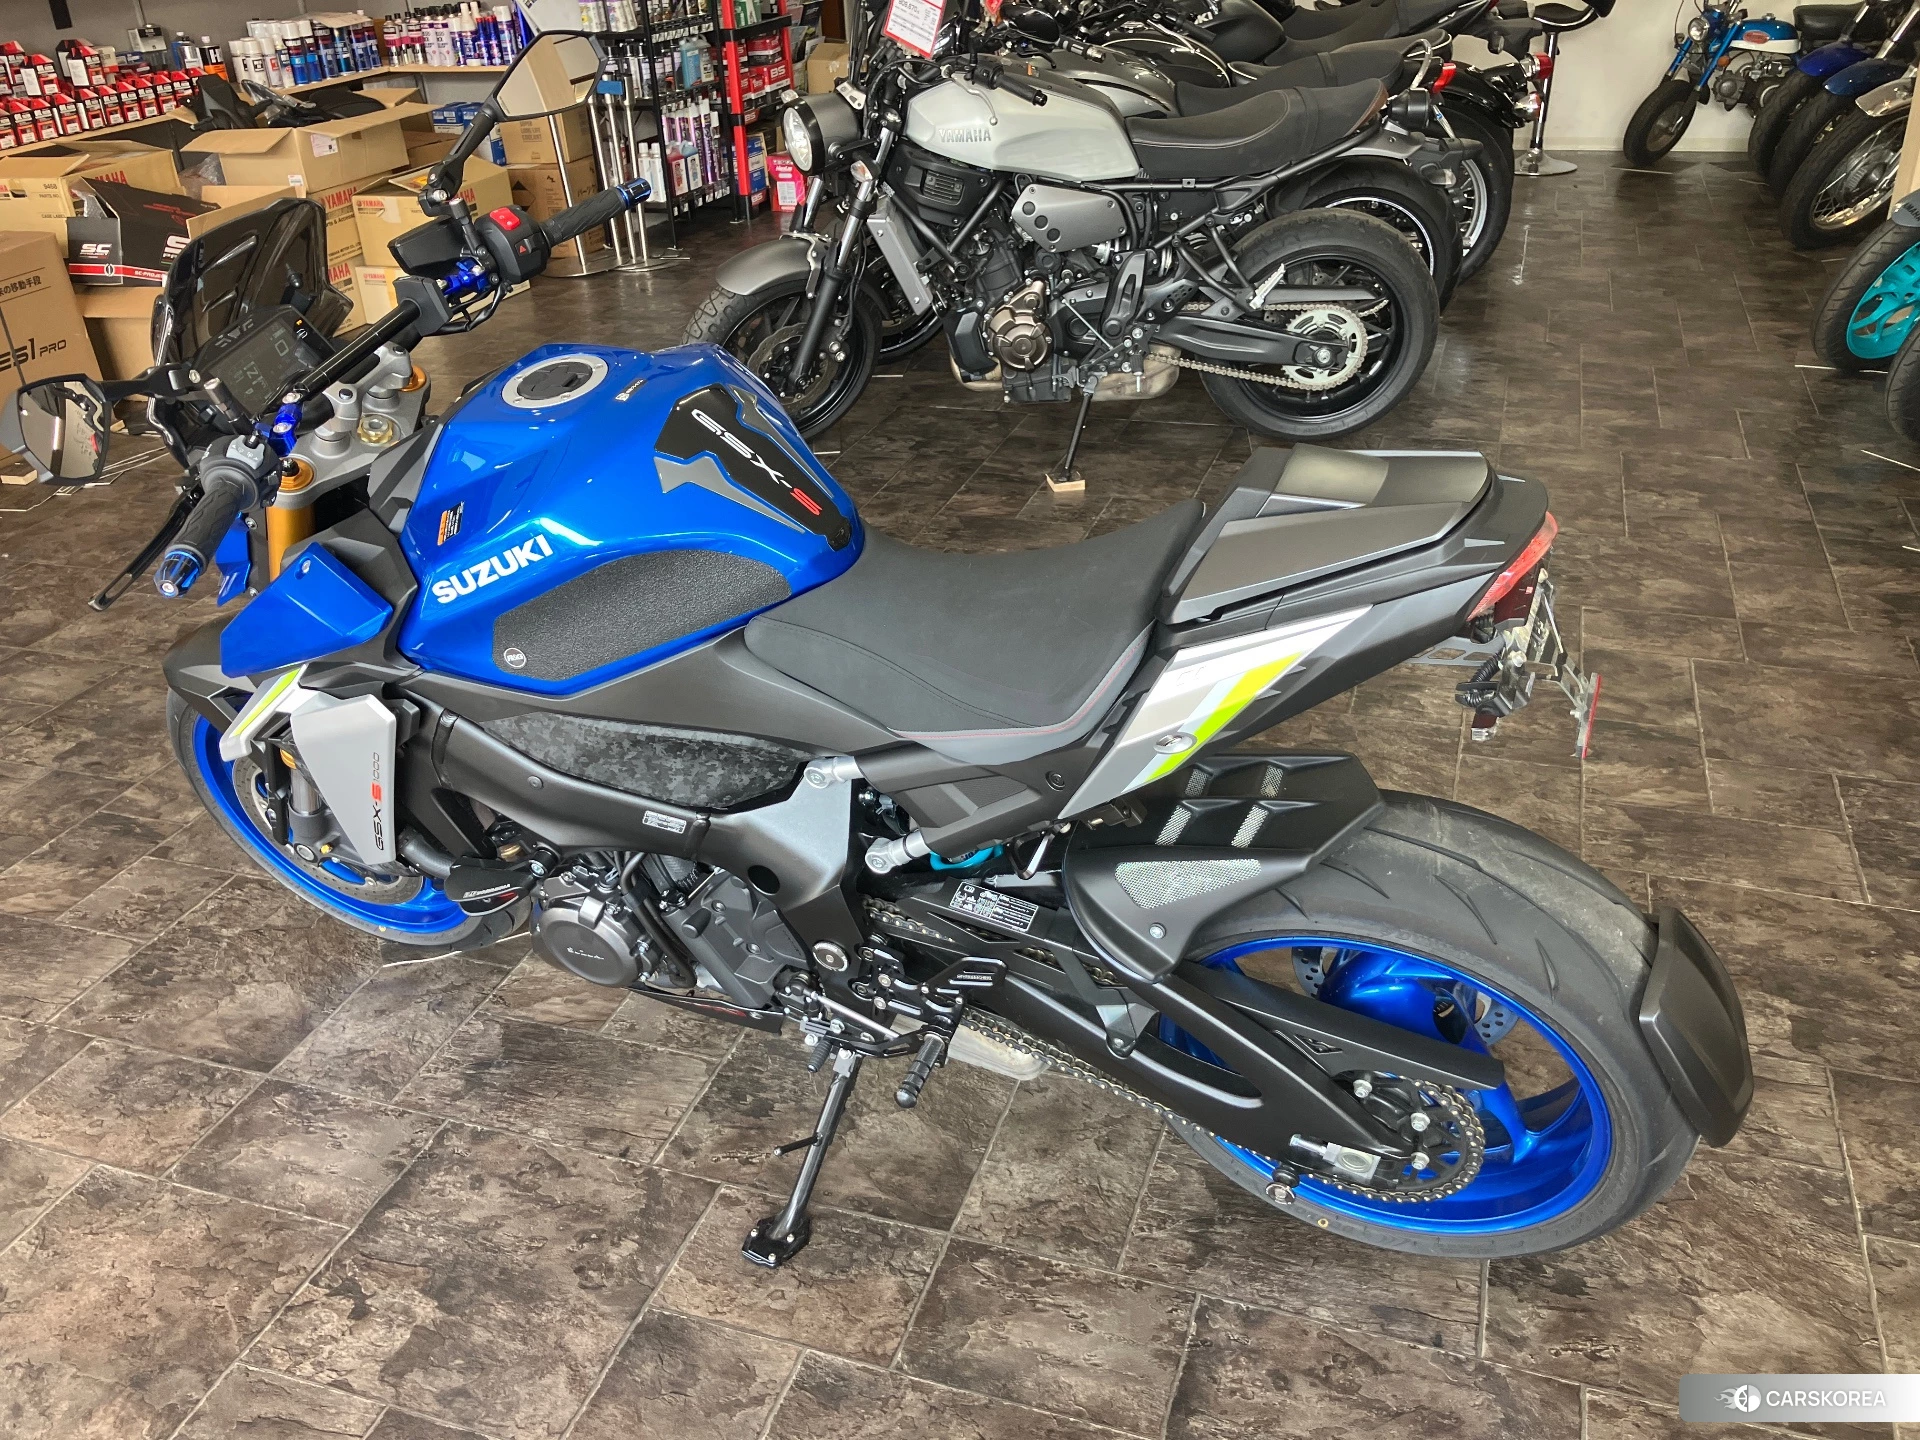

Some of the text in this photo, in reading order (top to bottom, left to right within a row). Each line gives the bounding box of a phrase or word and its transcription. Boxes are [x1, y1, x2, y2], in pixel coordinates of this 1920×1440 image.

[770, 65, 786, 78] BS
[938, 128, 992, 143] YAMAHA
[361, 200, 385, 208] YAMAHA
[81, 243, 112, 255] SC
[134, 270, 163, 279] SC-PROJE
[40, 340, 67, 358] PRO
[691, 408, 823, 516] GSX-S
[431, 534, 554, 604] SUZUKI
